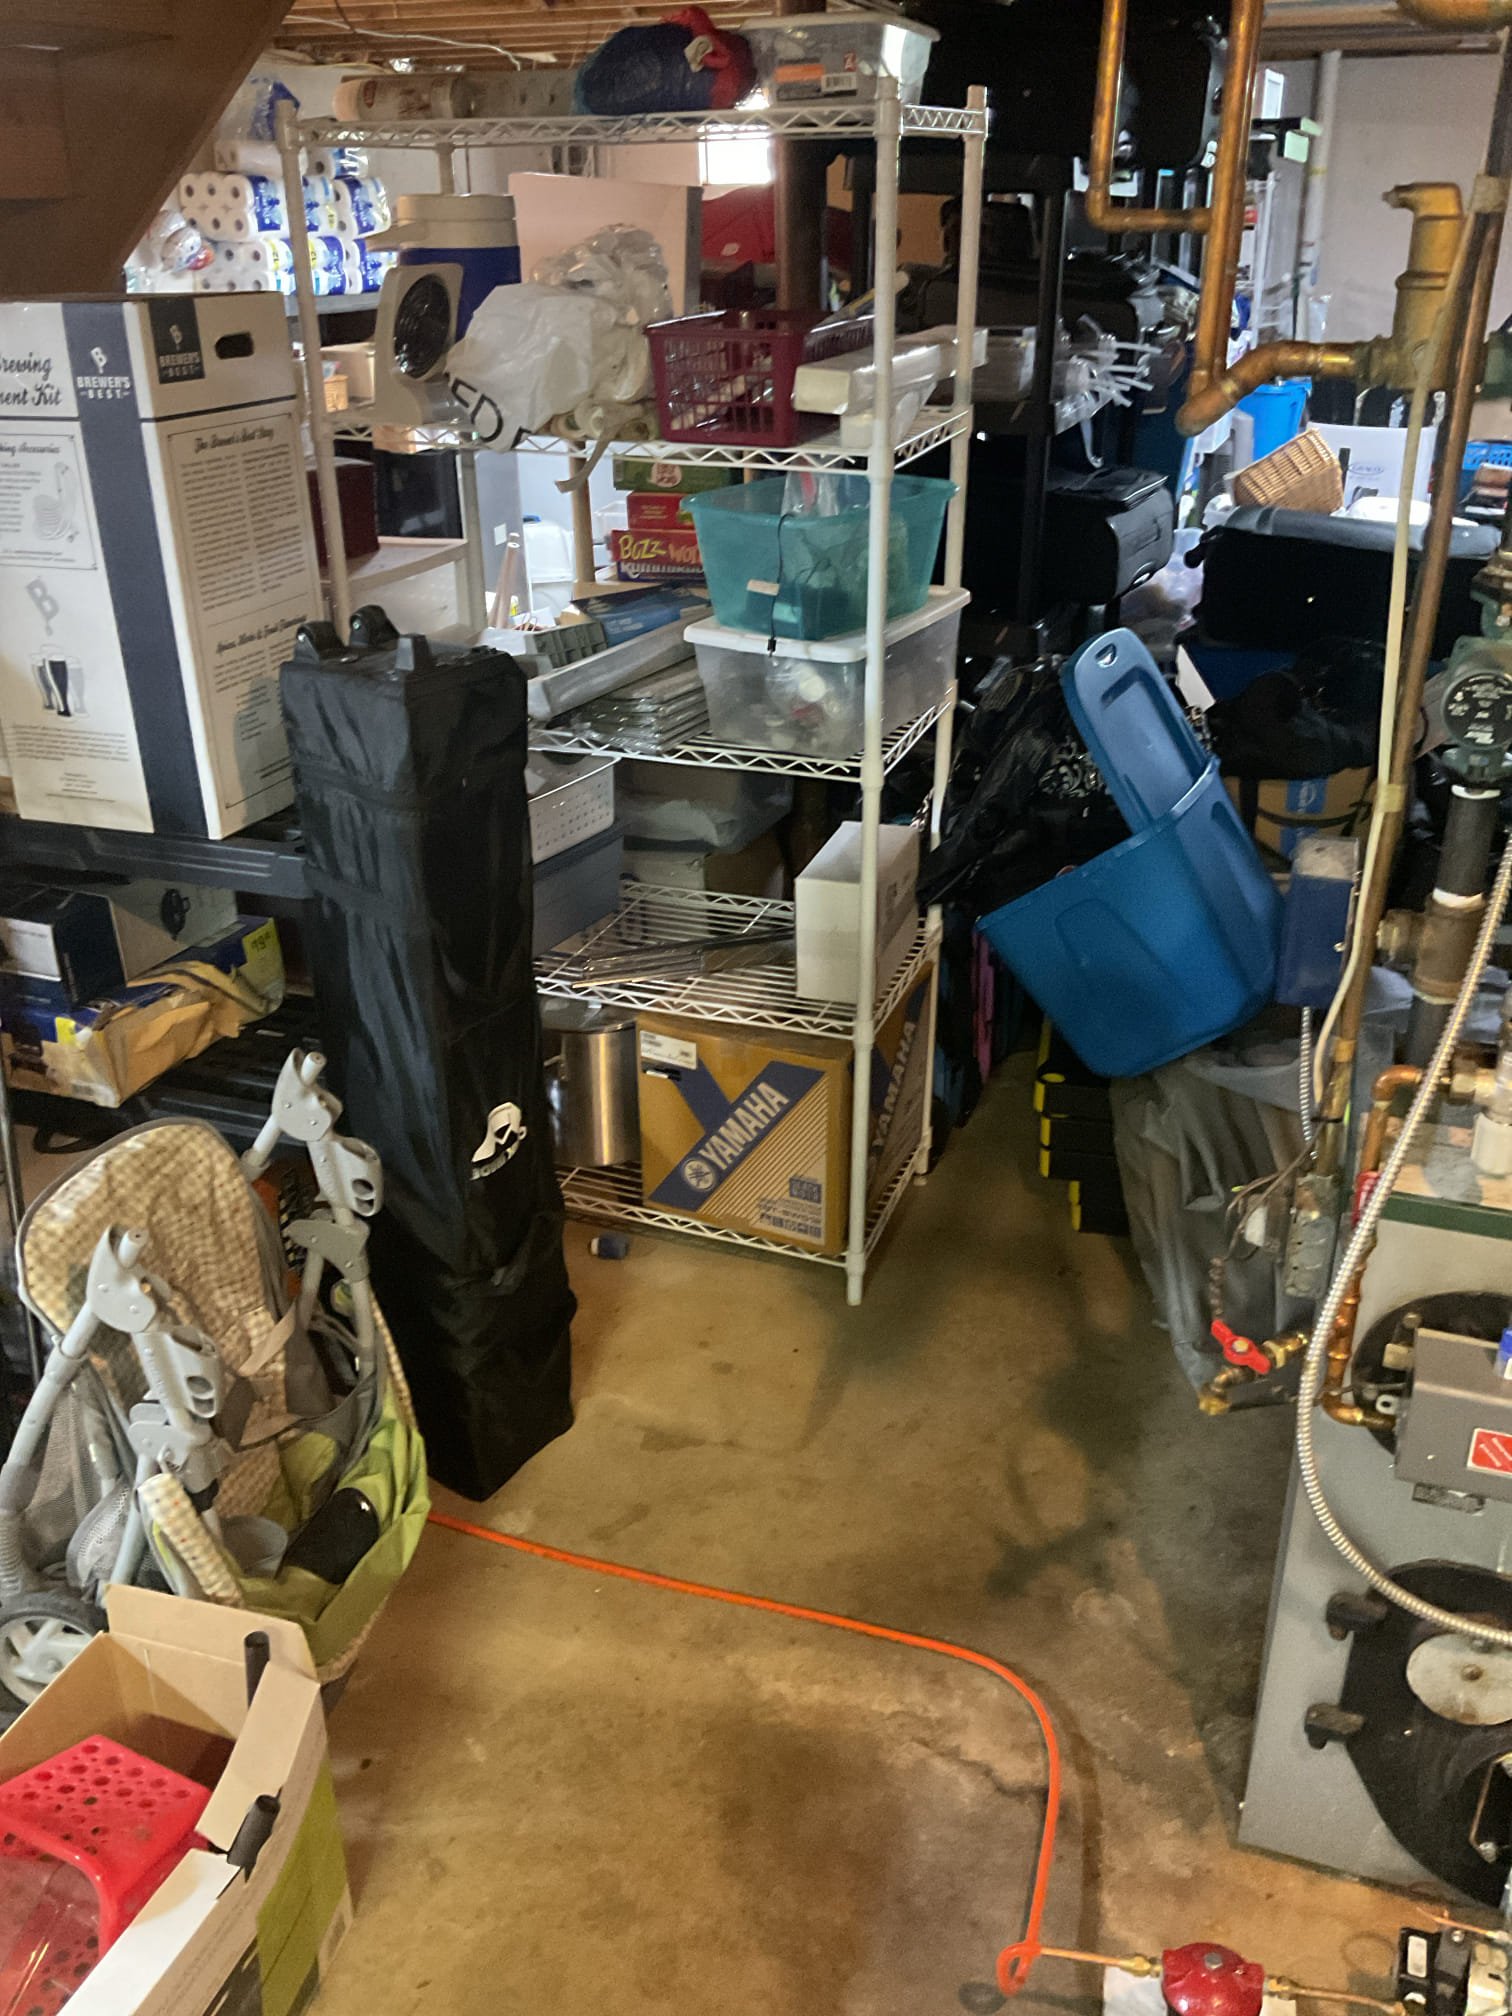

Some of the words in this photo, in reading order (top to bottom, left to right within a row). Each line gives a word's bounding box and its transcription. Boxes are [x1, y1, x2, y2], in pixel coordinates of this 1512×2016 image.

[0, 351, 51, 381] rewing
[77, 376, 131, 389] BREWER'S
[87, 388, 124, 399] BEST
[33, 383, 61, 406] Kit
[698, 1082, 789, 1170] YAMAHA
